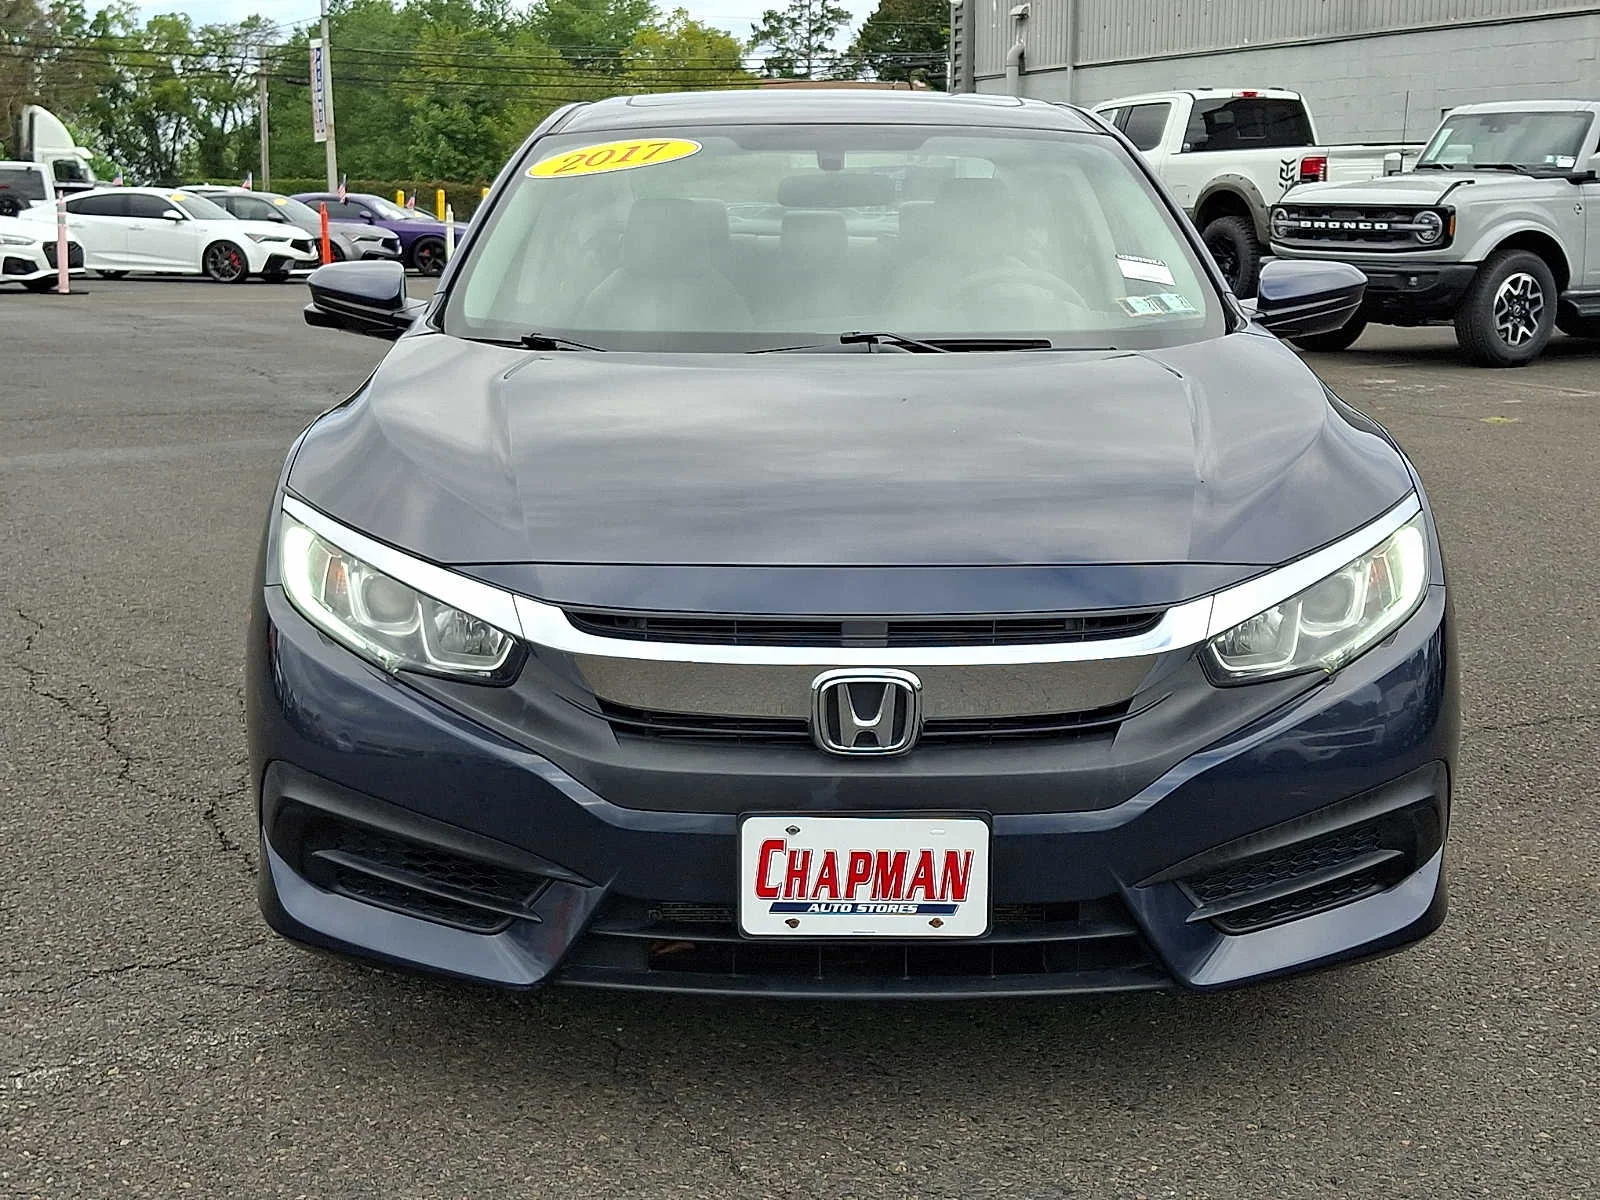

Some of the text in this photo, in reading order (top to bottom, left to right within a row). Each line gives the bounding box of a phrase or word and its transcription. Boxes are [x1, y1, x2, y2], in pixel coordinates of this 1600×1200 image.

[553, 142, 671, 174] 2017
[1300, 221, 1389, 231] BRONCO
[755, 838, 974, 902] CHAPMAN
[807, 904, 918, 914] AUTO STORES
